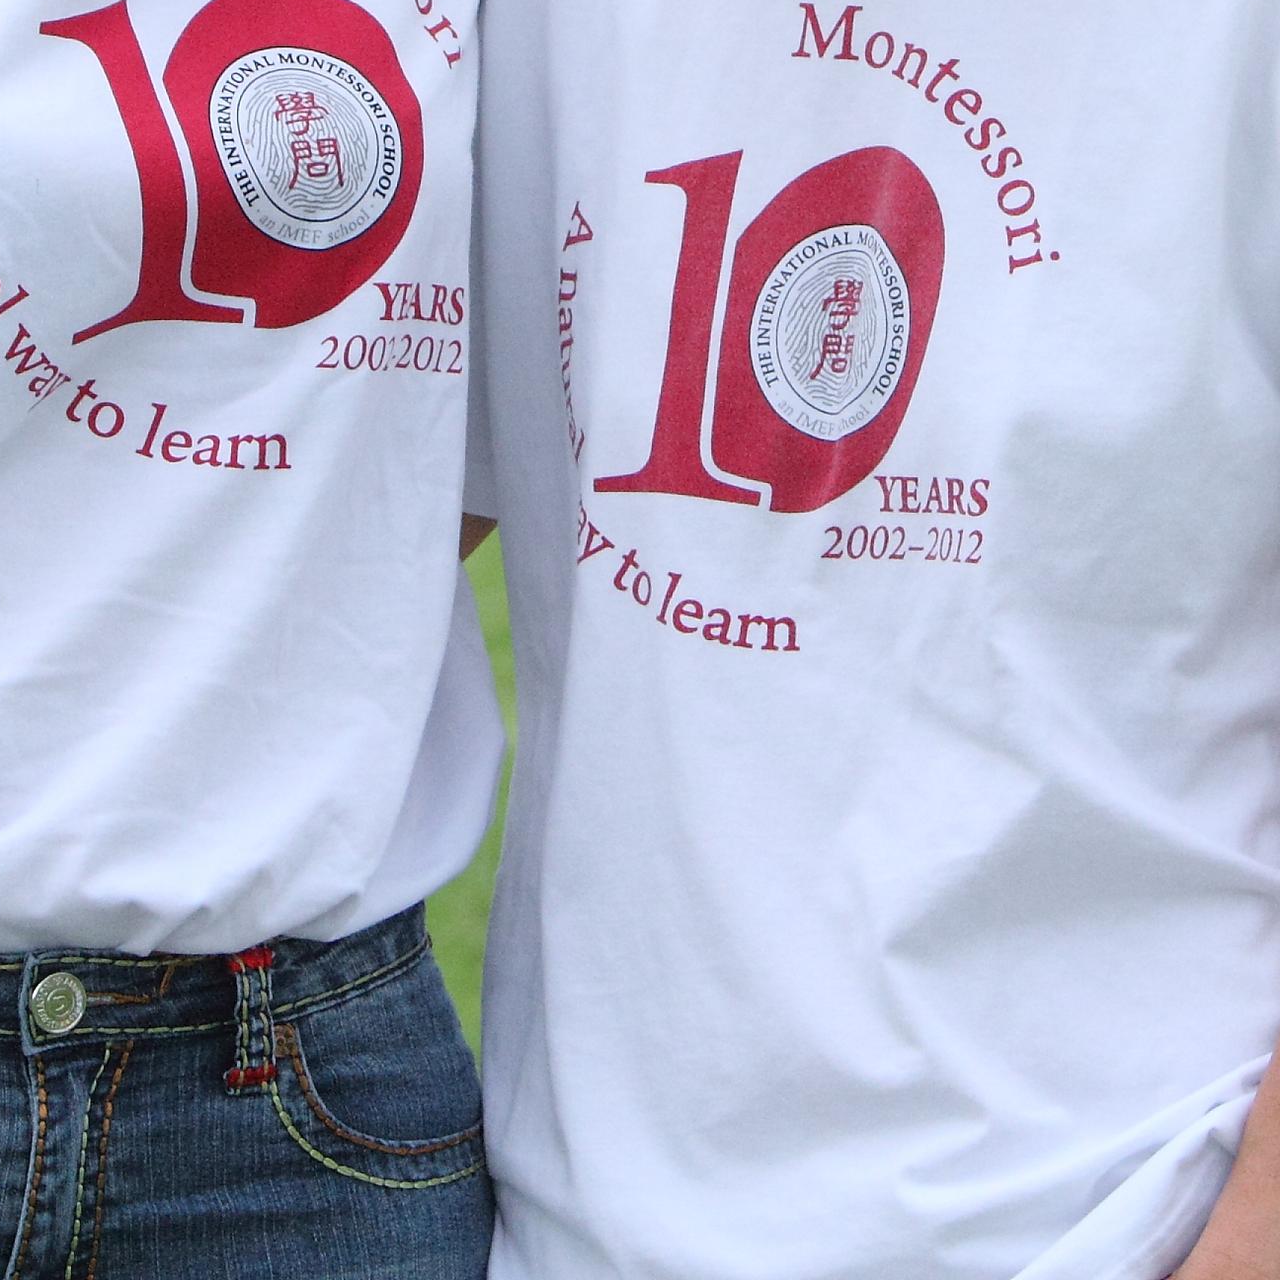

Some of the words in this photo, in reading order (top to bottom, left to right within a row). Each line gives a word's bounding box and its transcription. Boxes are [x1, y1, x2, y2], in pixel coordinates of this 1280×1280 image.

[217, 55, 274, 167] INTERNATIONAL
[278, 52, 387, 121] MONTESSORI
[372, 123, 396, 200] SCHOOL
[791, 1, 1061, 275] Montessori
[235, 170, 260, 208] THE
[327, 210, 371, 244] school
[757, 231, 854, 347] INTERNATIONAL
[857, 230, 905, 320] MONTESSORI
[592, 145, 946, 514] 10
[872, 323, 905, 398] SCHOOL
[758, 351, 779, 388] THE
[65, 379, 126, 438] to
[135, 402, 293, 471] learn
[562, 200, 595, 253] A
[613, 547, 653, 608] to
[656, 571, 801, 653] learn
[874, 474, 991, 517] YEARS
[820, 524, 985, 565] 2002–2012
